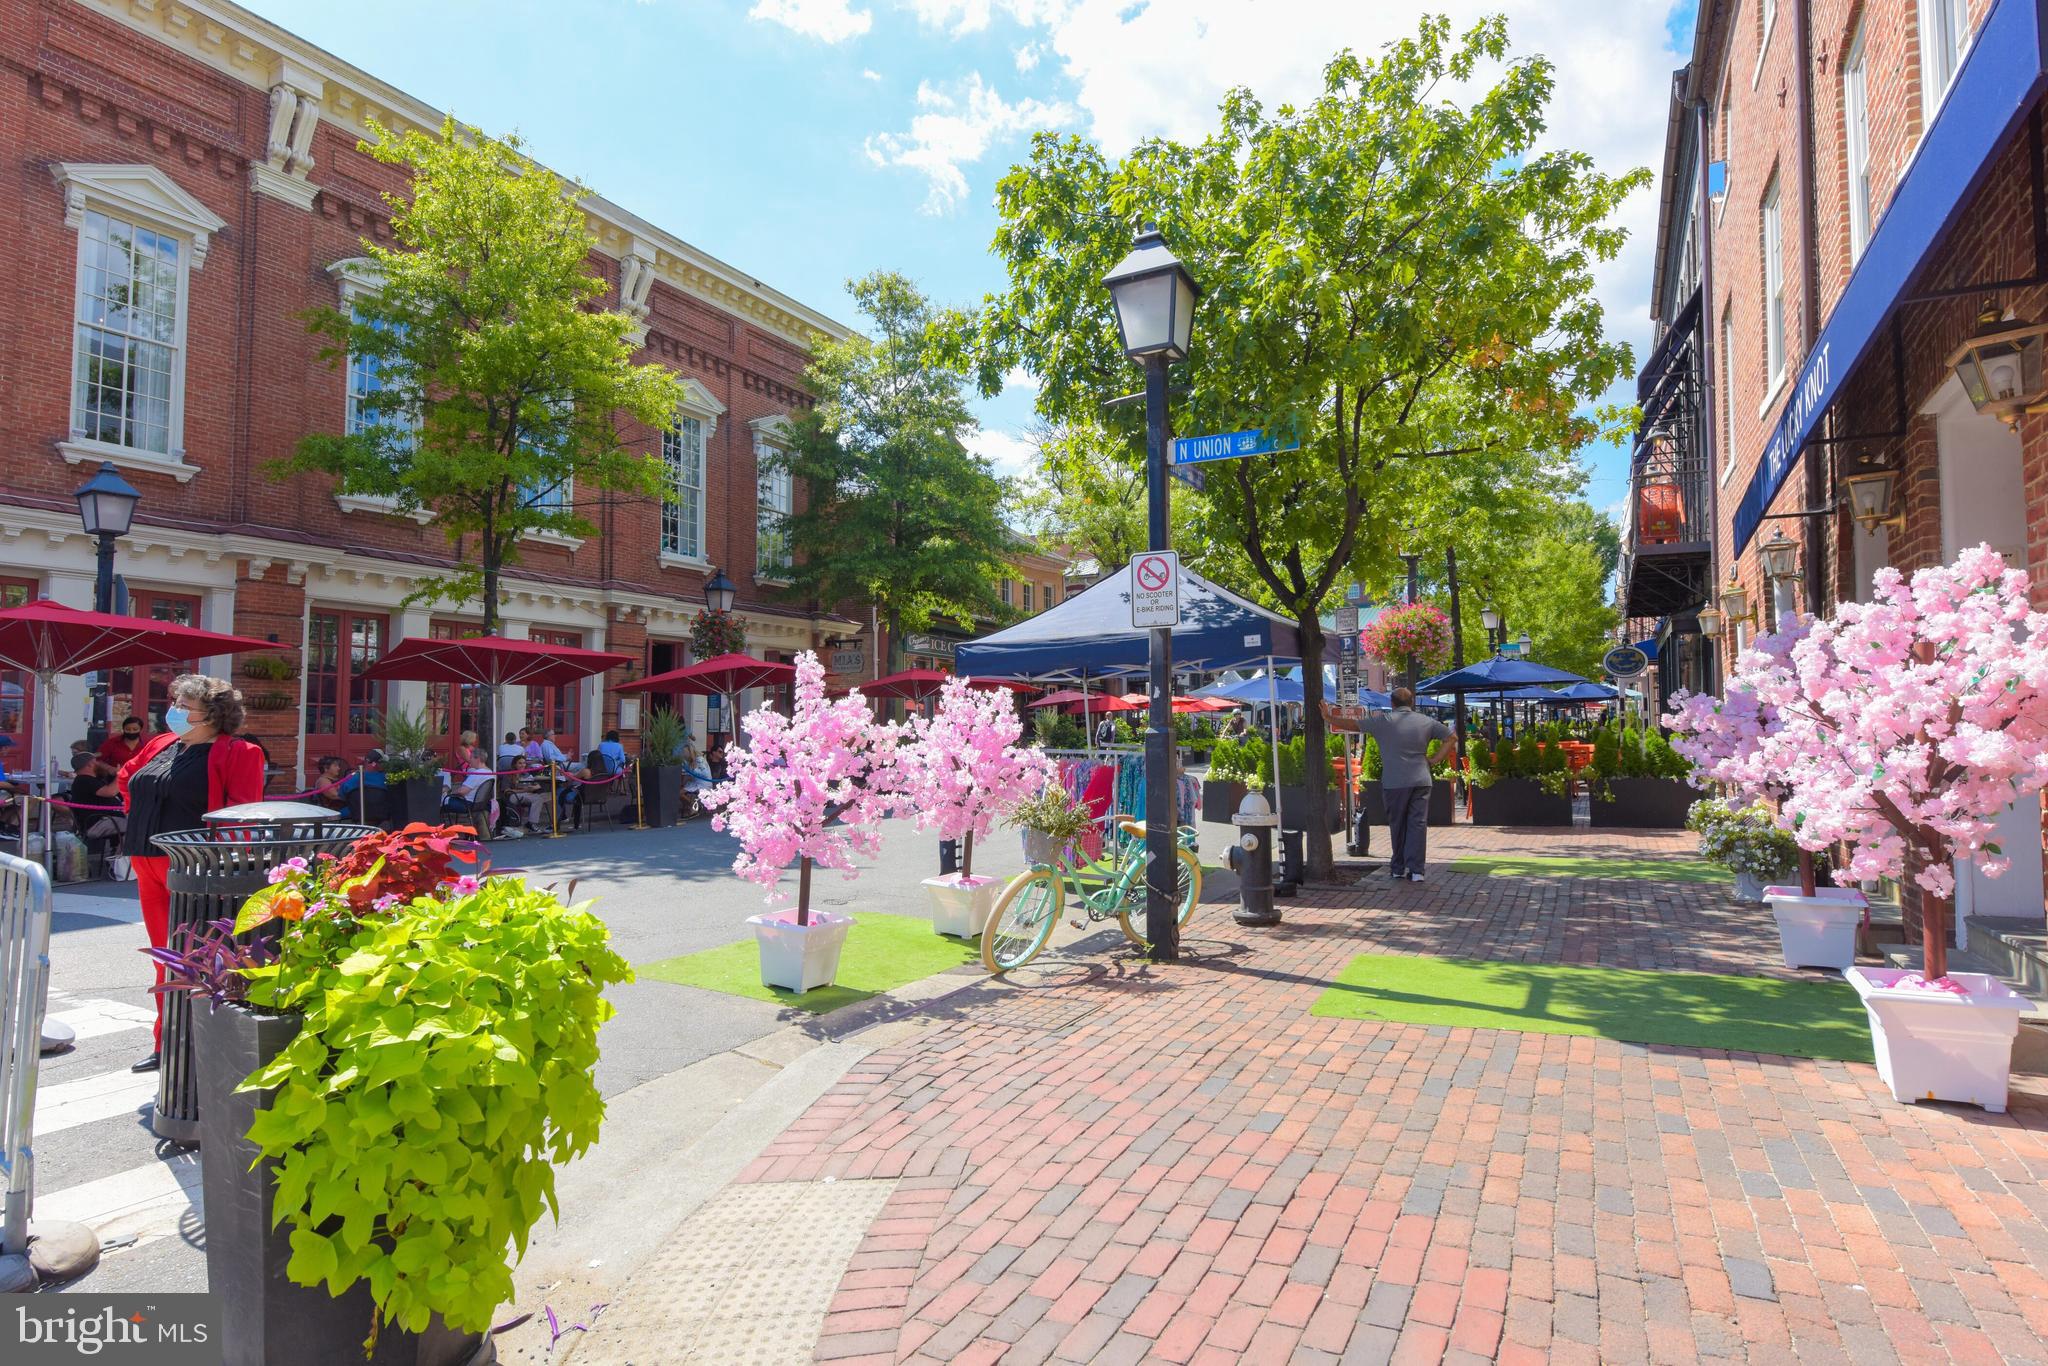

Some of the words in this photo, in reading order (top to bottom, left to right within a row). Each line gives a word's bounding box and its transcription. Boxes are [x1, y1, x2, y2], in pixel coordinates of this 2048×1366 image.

[1769, 437, 1781, 482] THE
[1781, 391, 1803, 458] LUCKY
[1804, 342, 1830, 418] KNOT
[1180, 442, 1188, 460] N
[1194, 437, 1231, 459] UNION
[1136, 592, 1145, 600] NO
[1146, 591, 1173, 599] SCOOTER
[1136, 605, 1154, 613] E-BIKE
[1155, 604, 1174, 612] RIDING
[930, 639, 947, 651] ICE
[1343, 637, 1351, 650] P
